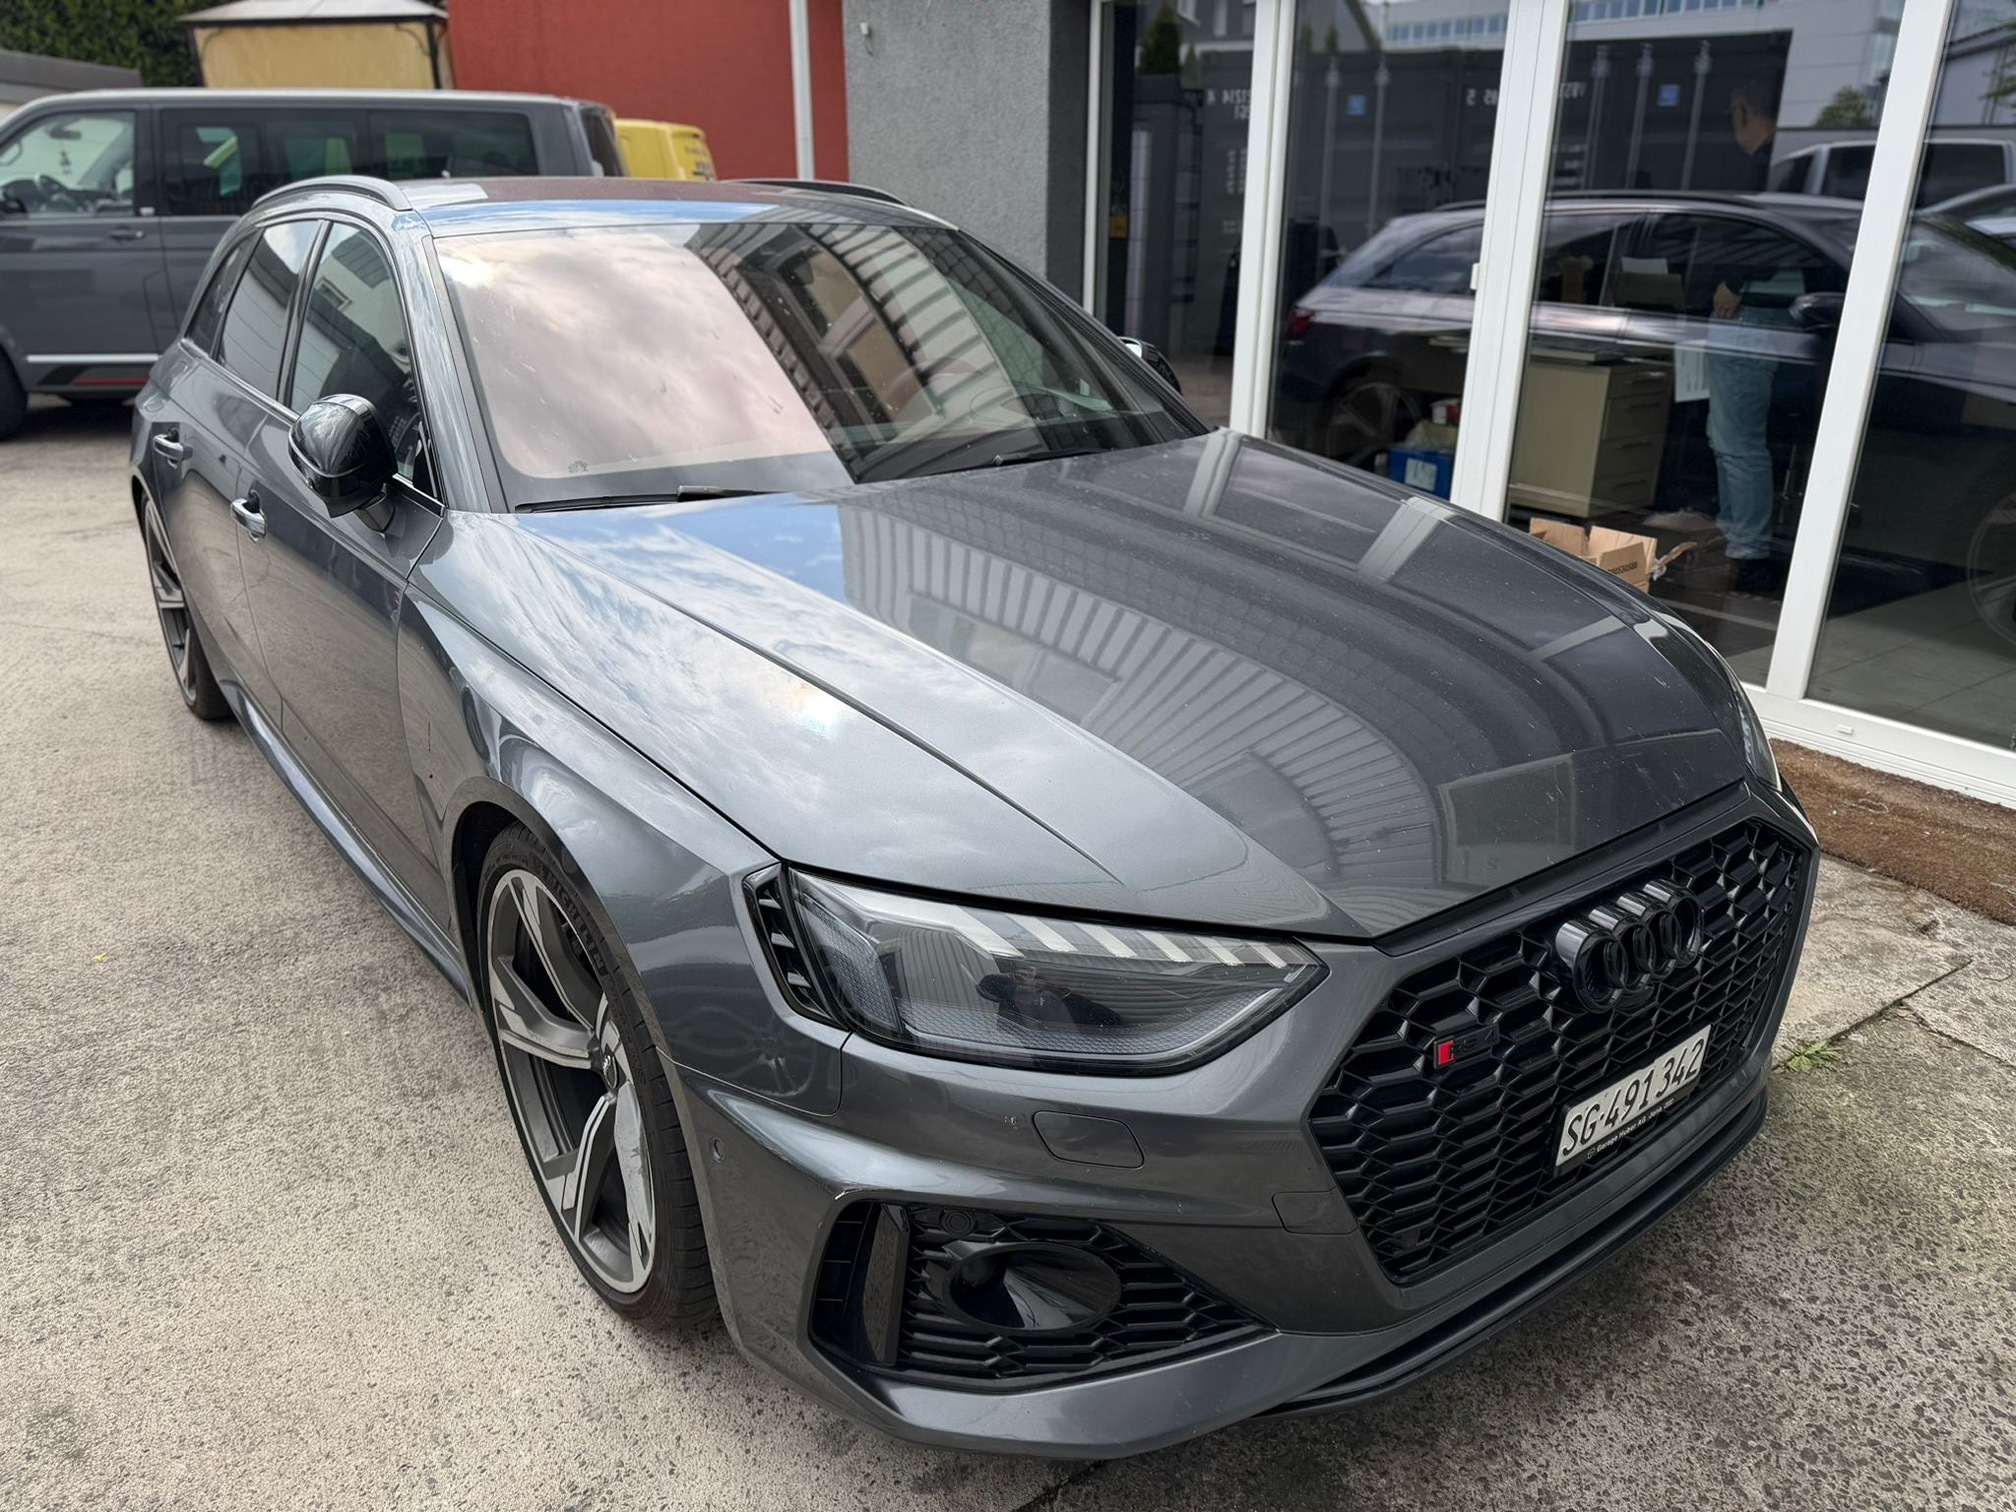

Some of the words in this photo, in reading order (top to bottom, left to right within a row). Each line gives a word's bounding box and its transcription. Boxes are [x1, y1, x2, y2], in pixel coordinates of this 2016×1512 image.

[547, 872, 604, 968] MICHELIN
[1596, 1135, 1618, 1152] Garage
[1619, 1123, 1637, 1139] Huber
